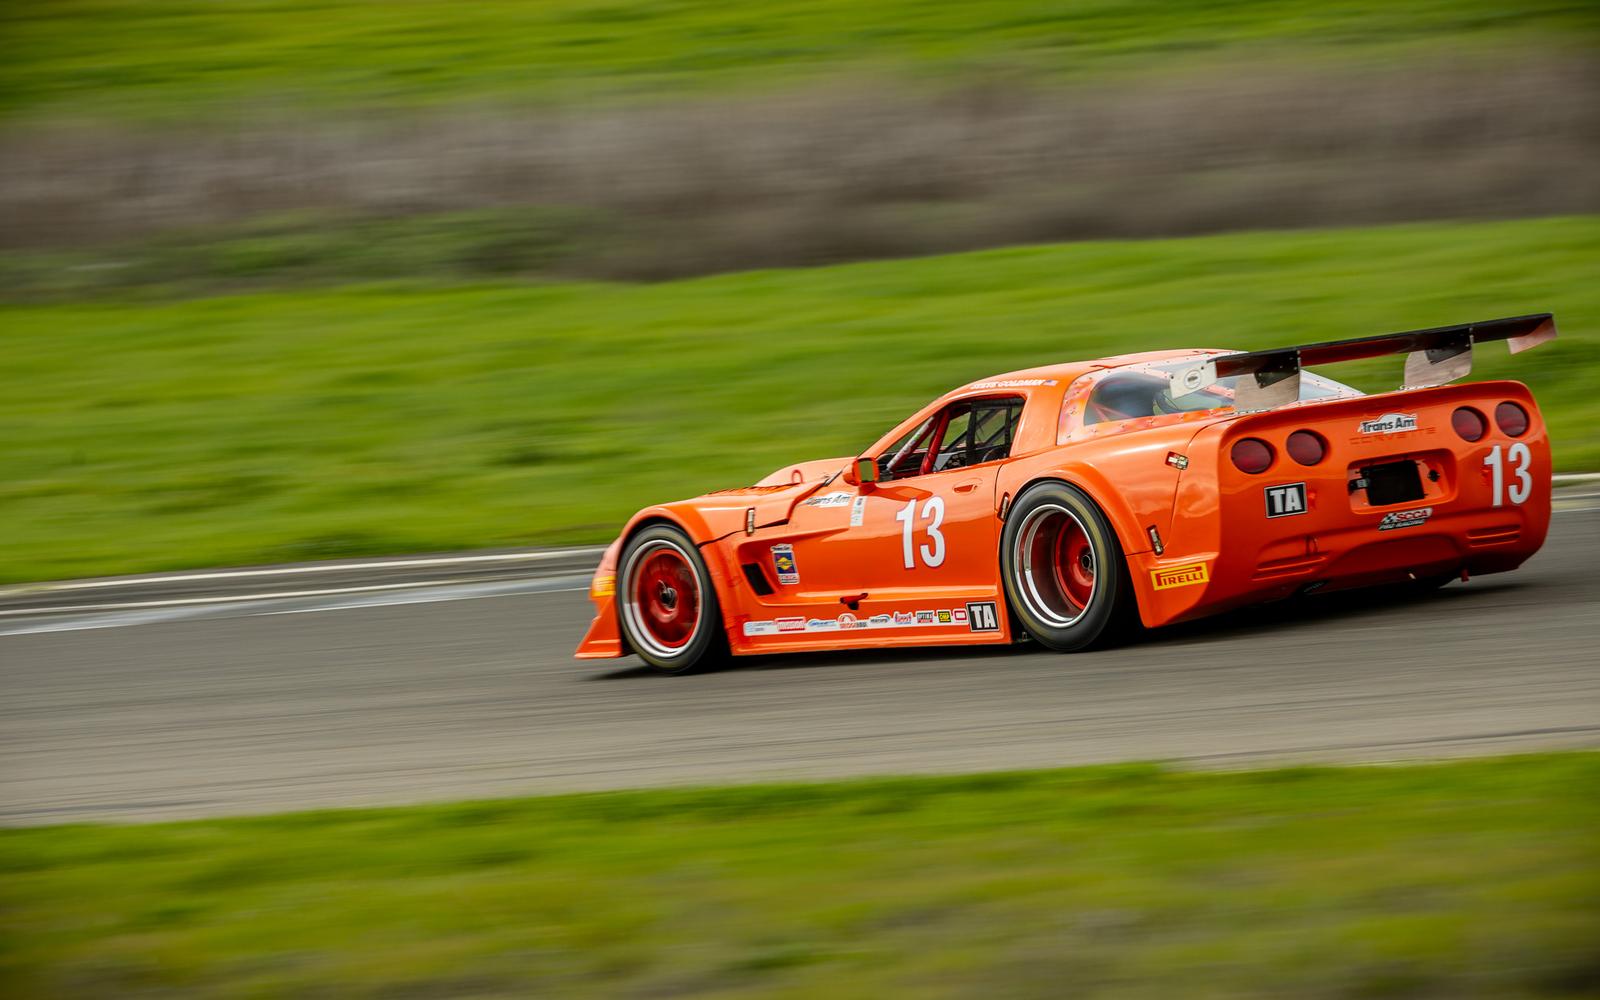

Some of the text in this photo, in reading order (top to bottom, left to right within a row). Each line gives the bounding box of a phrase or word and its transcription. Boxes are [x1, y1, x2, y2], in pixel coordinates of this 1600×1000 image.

[1362, 417, 1415, 432] Trans Am
[1483, 442, 1533, 506] 13
[1269, 487, 1303, 513] TA
[1396, 510, 1428, 522] SCCA
[896, 496, 946, 569] 13
[1154, 566, 1204, 587] PIRELLI
[970, 604, 997, 629] TA
